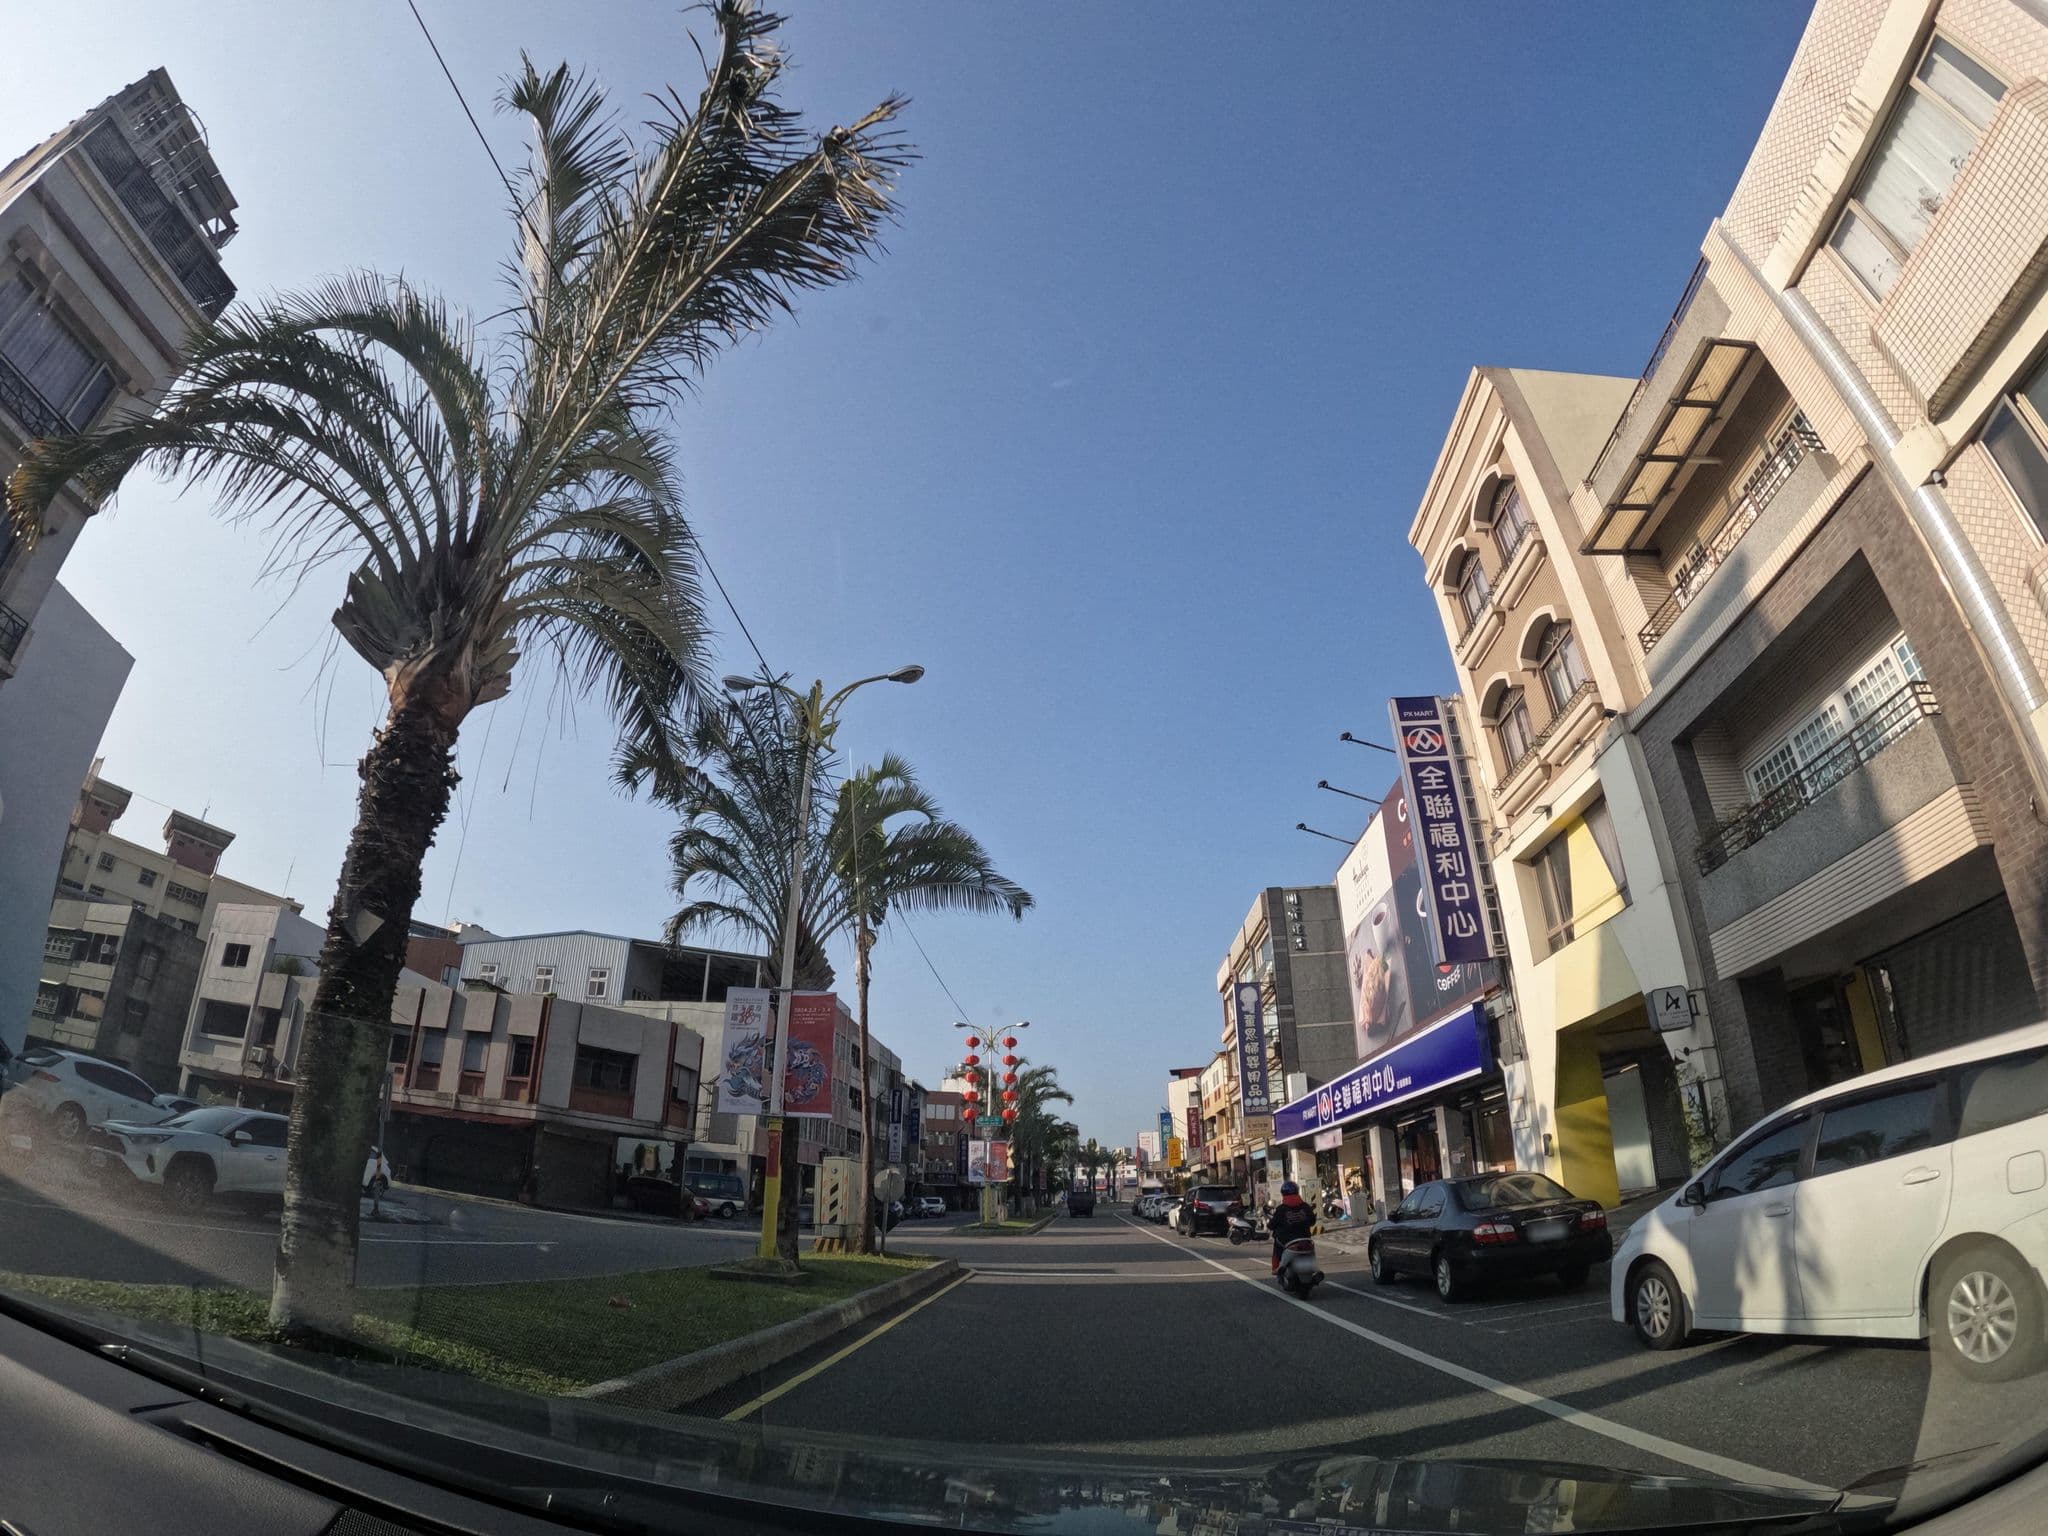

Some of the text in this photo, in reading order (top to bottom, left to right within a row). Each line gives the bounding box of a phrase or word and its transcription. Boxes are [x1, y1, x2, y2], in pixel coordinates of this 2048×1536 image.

[1418, 765, 1477, 938] 全聯福利中心
[1334, 1064, 1395, 1114] 全聯福利中心
